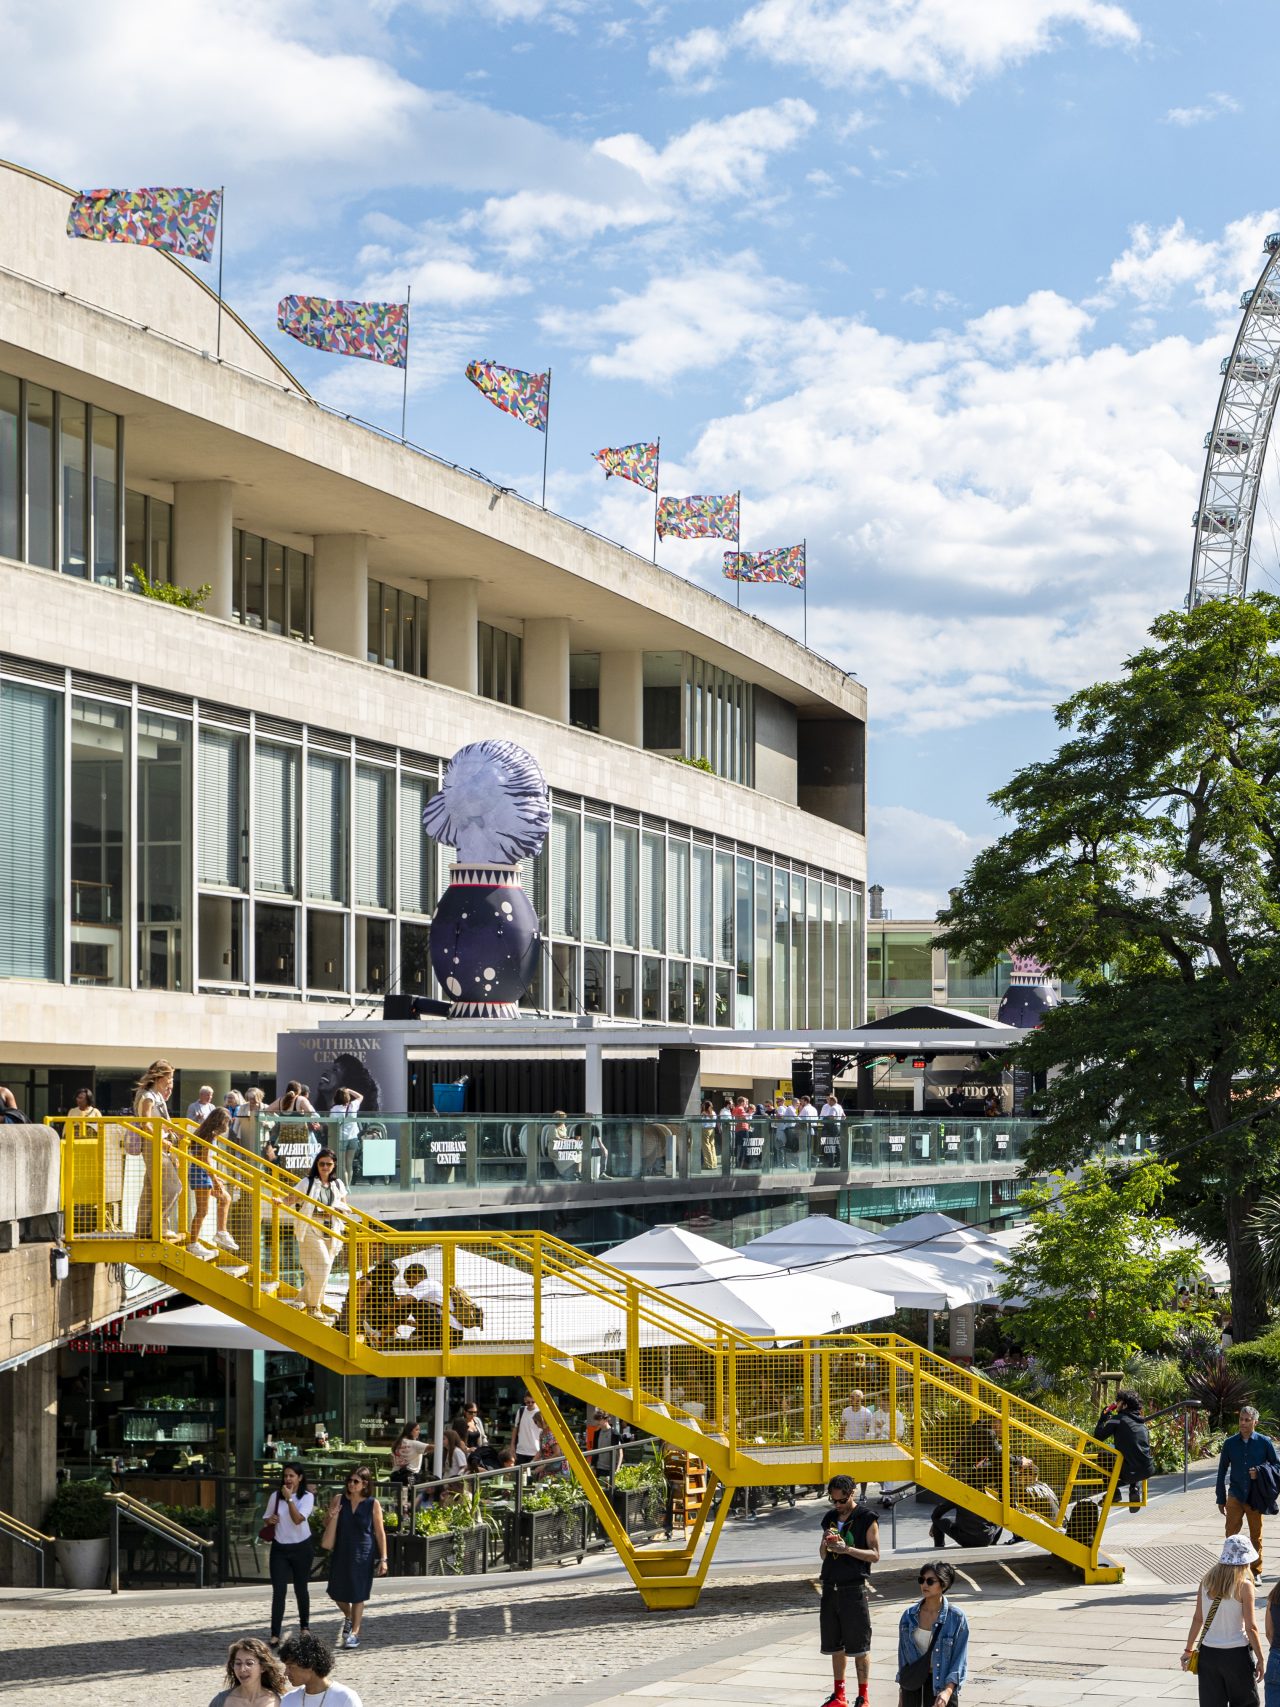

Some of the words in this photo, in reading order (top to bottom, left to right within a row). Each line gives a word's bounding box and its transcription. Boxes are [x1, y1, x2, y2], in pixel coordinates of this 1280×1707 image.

[298, 1038, 382, 1050] SOUTHBANK
[431, 1141, 467, 1152] SOUTHBANK
[437, 1153, 461, 1164] CENTRE
